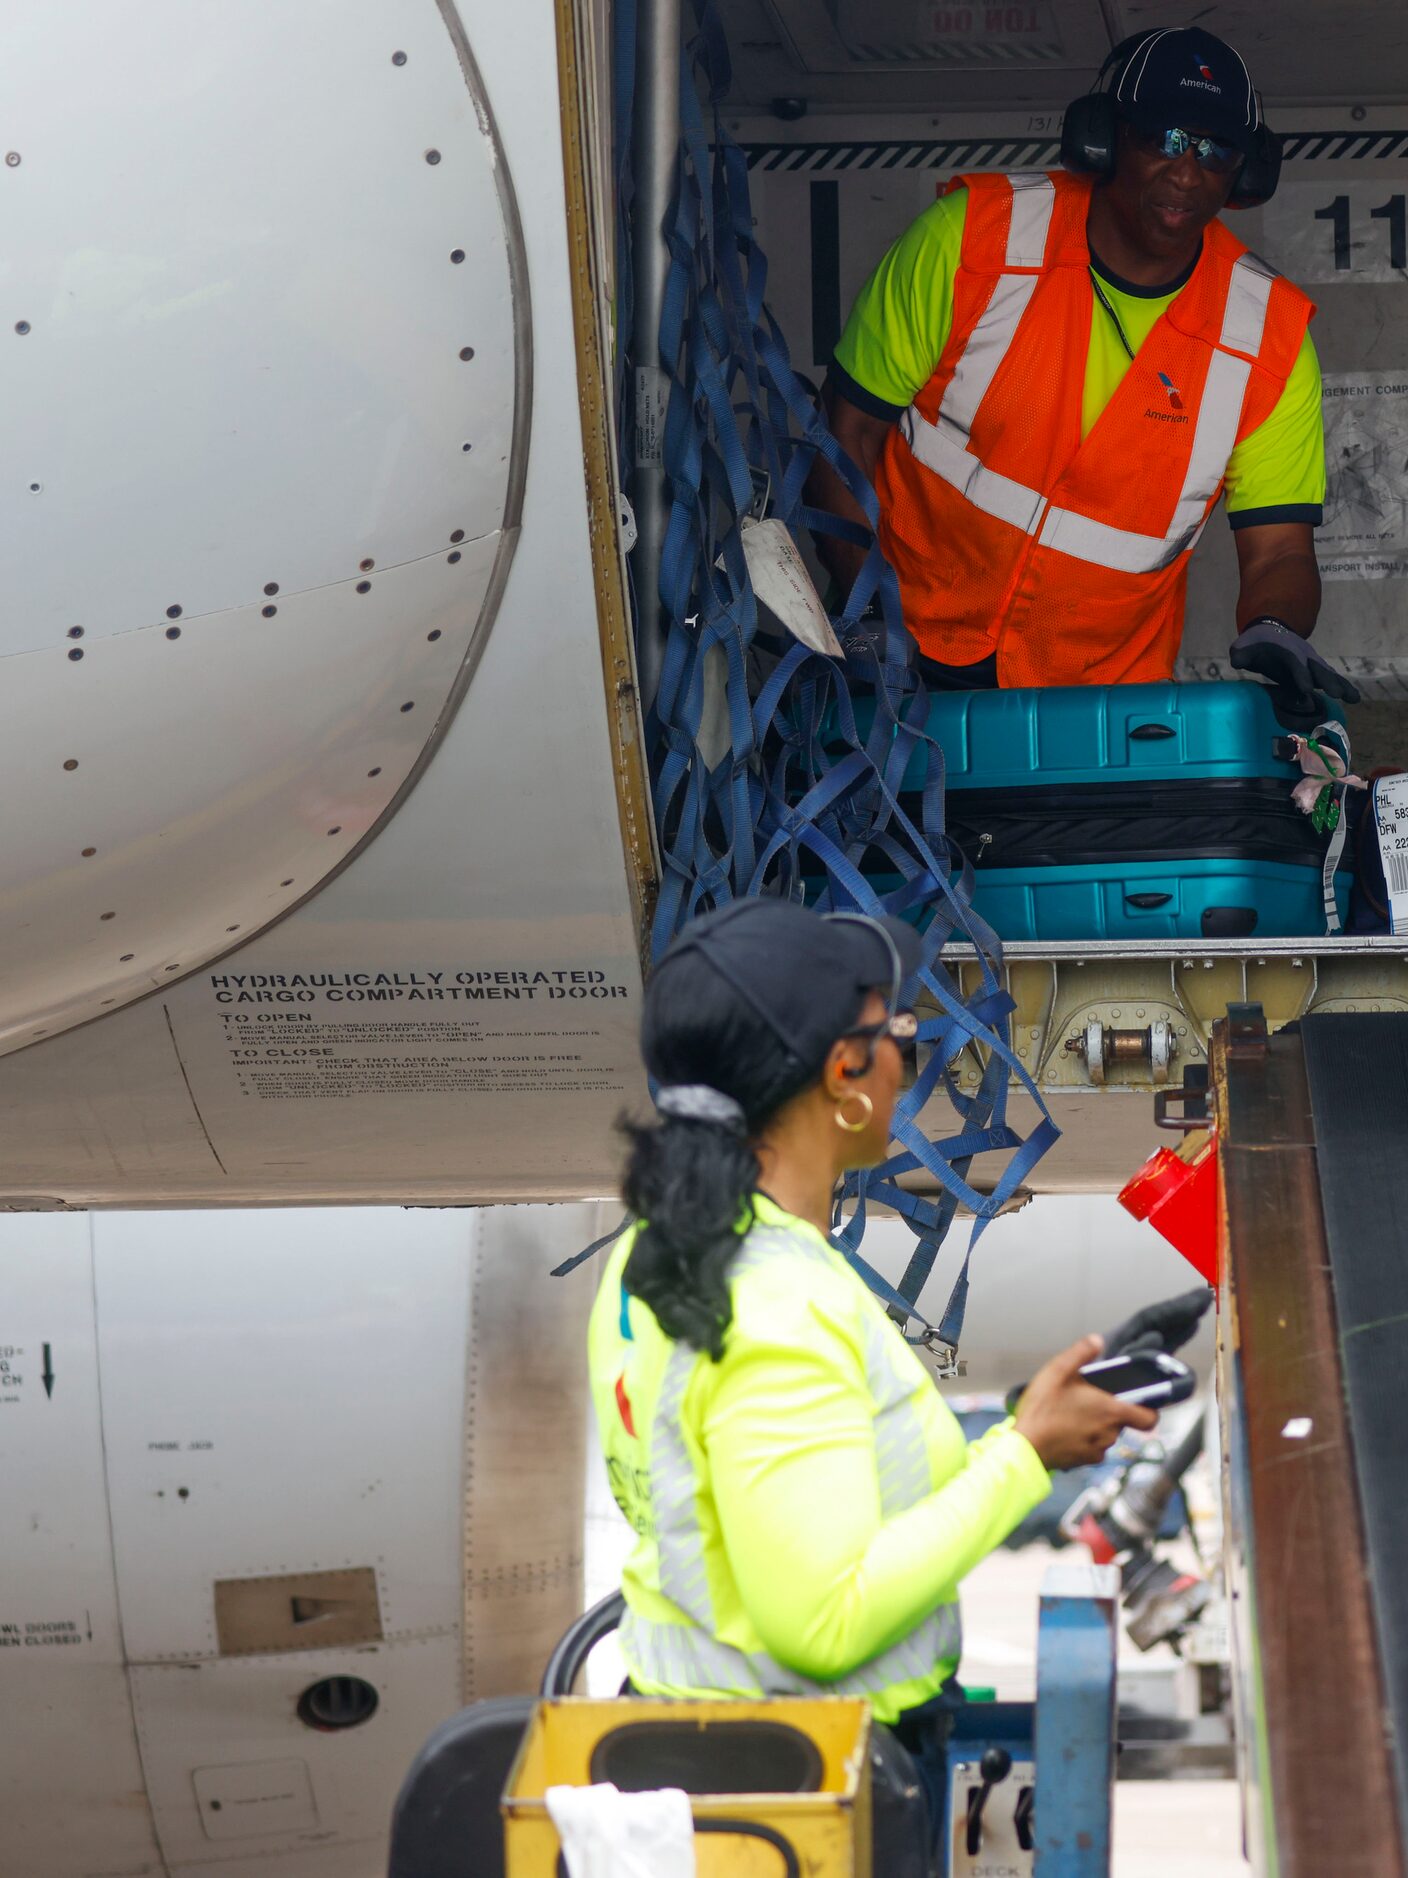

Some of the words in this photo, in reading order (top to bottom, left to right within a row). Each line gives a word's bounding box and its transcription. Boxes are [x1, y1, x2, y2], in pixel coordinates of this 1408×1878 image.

[1180, 77, 1221, 94] American
[1314, 194, 1407, 270] 11
[1321, 385, 1370, 398] GEMENT
[1144, 408, 1189, 424] American
[1320, 564, 1361, 573] ANSPORT
[1375, 794, 1392, 806] PHL
[1379, 823, 1397, 836] DFW
[211, 972, 444, 988] HYDRAULICALLY
[456, 971, 606, 985] OPERATED
[216, 990, 316, 1003] CARGO
[327, 987, 538, 1002] COMPARTMENT
[550, 986, 629, 999] DOOR
[221, 1014, 249, 1023] TO
[257, 1013, 312, 1023] OPEN
[266, 1048, 334, 1057] CLOSE
